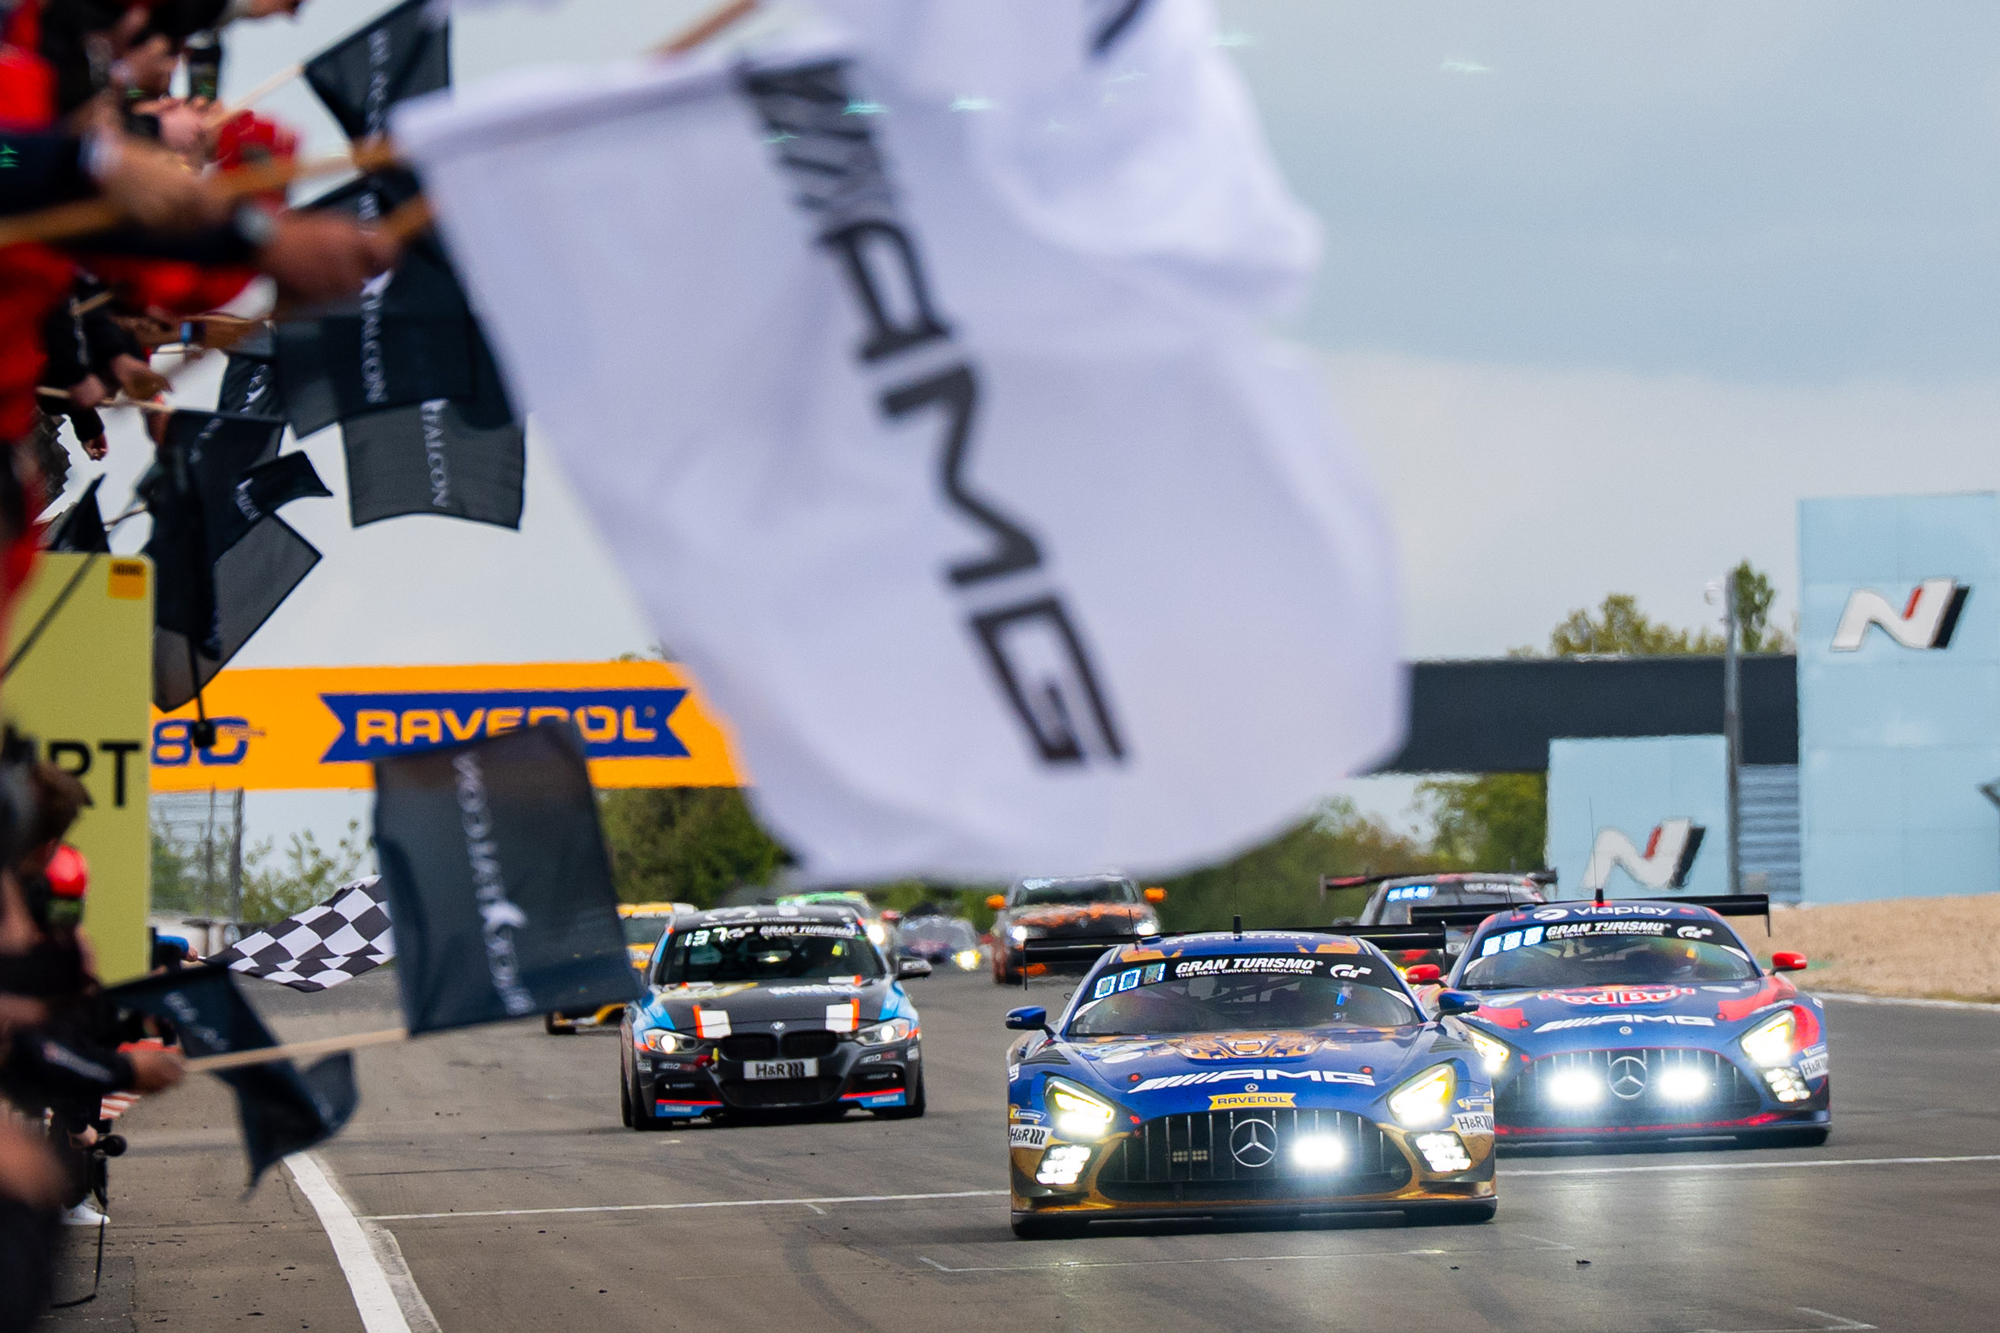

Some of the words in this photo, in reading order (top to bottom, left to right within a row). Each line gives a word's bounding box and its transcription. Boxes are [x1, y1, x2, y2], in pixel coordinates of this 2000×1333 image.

[816, 218, 1130, 766] AMG
[1573, 905, 1673, 918] viaplay
[1545, 922, 1592, 937] GRAN
[1595, 921, 1666, 932] TURISMO
[1175, 959, 1229, 974] GRAN
[1233, 957, 1316, 970] TURISMO
[756, 1063, 785, 1077] H&R
[1217, 1095, 1288, 1106] RAVENOL
[1458, 1115, 1484, 1130] H&R
